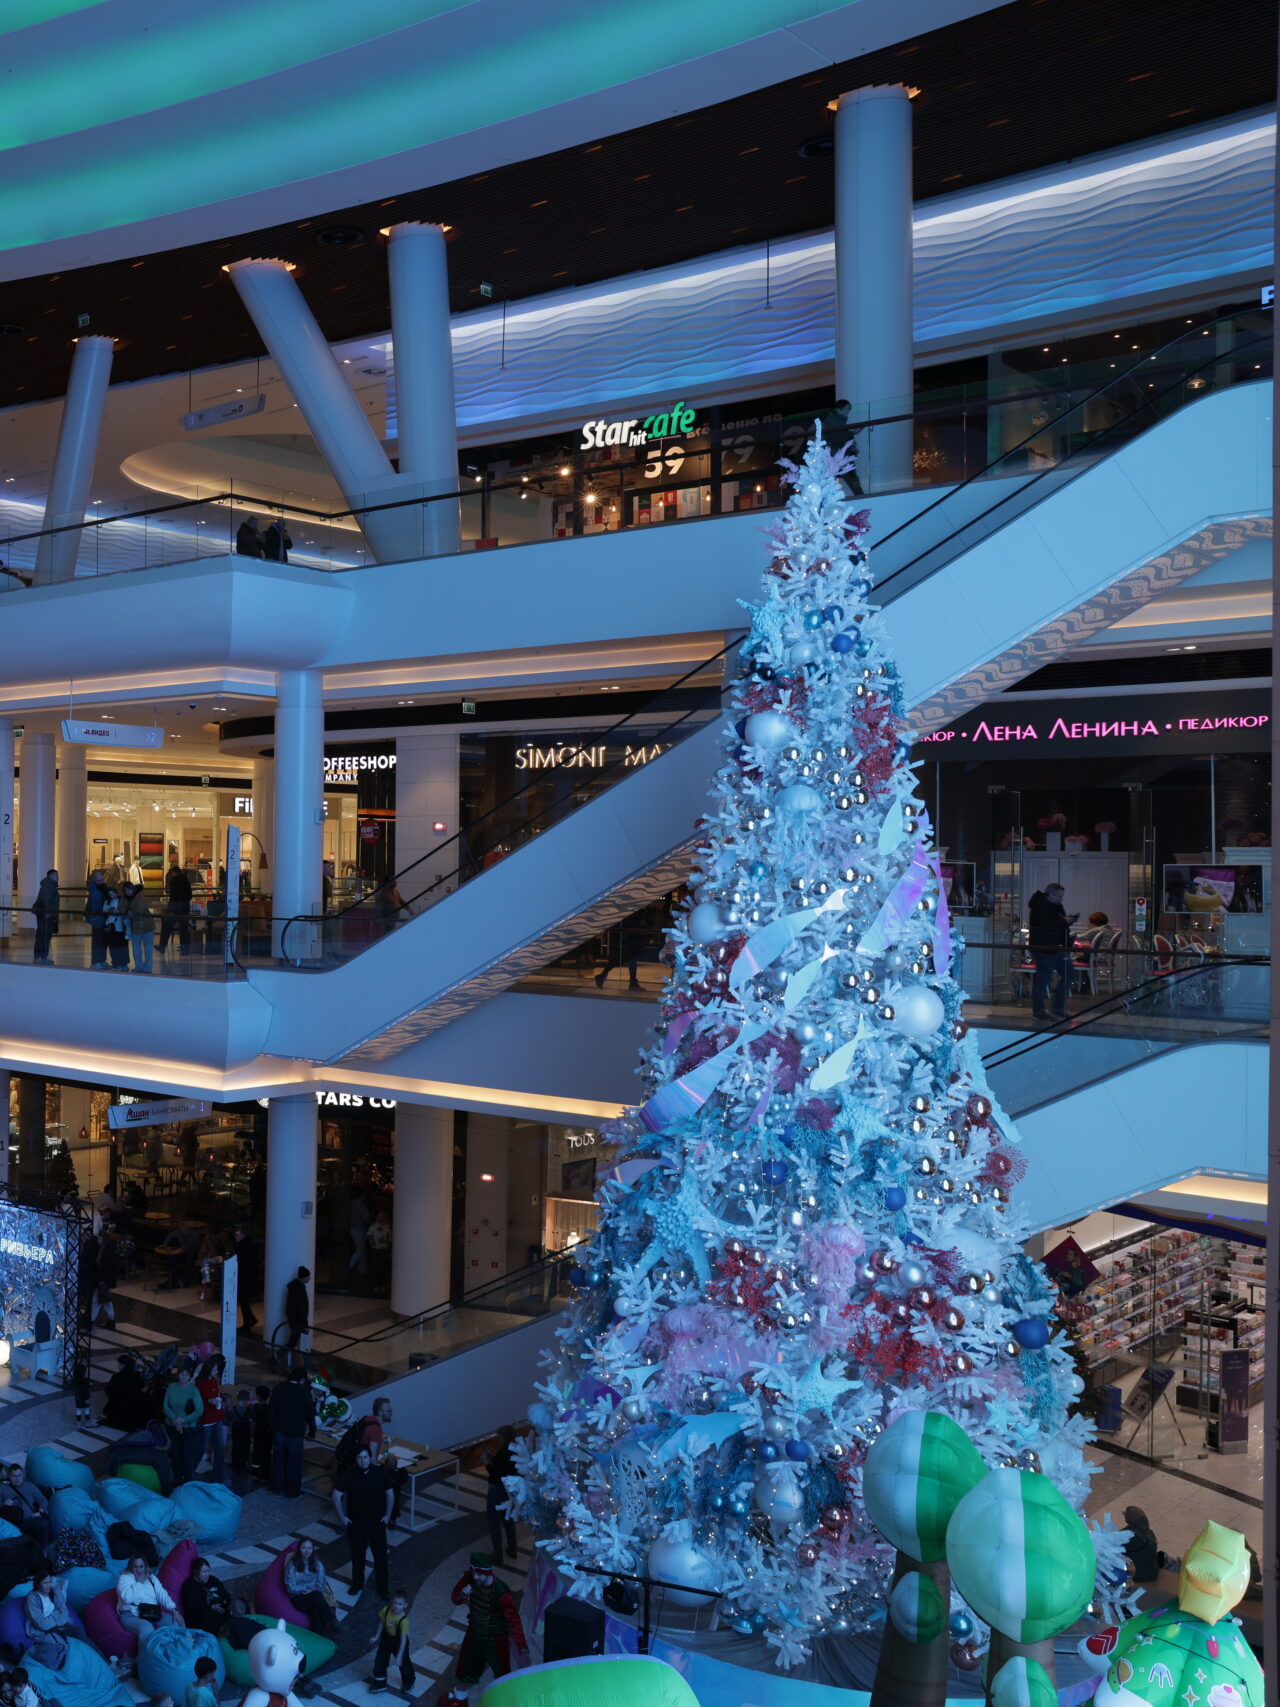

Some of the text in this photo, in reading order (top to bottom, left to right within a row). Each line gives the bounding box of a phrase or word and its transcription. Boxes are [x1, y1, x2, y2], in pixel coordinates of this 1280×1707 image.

[580, 402, 696, 450] Star hit cafe
[644, 446, 686, 478] 59
[1179, 715, 1269, 730] ПЕДИКЮР
[324, 755, 397, 771] OFFEESHOP
[324, 773, 358, 782] MPANY
[4, 813, 10, 825] 2
[200, 1102, 205, 1112] 1
[315, 1091, 363, 1107] TARS
[0, 1140, 5, 1151] 1
[566, 1133, 595, 1149] TOUS
[0, 1238, 54, 1265] РИВЬЕРА
